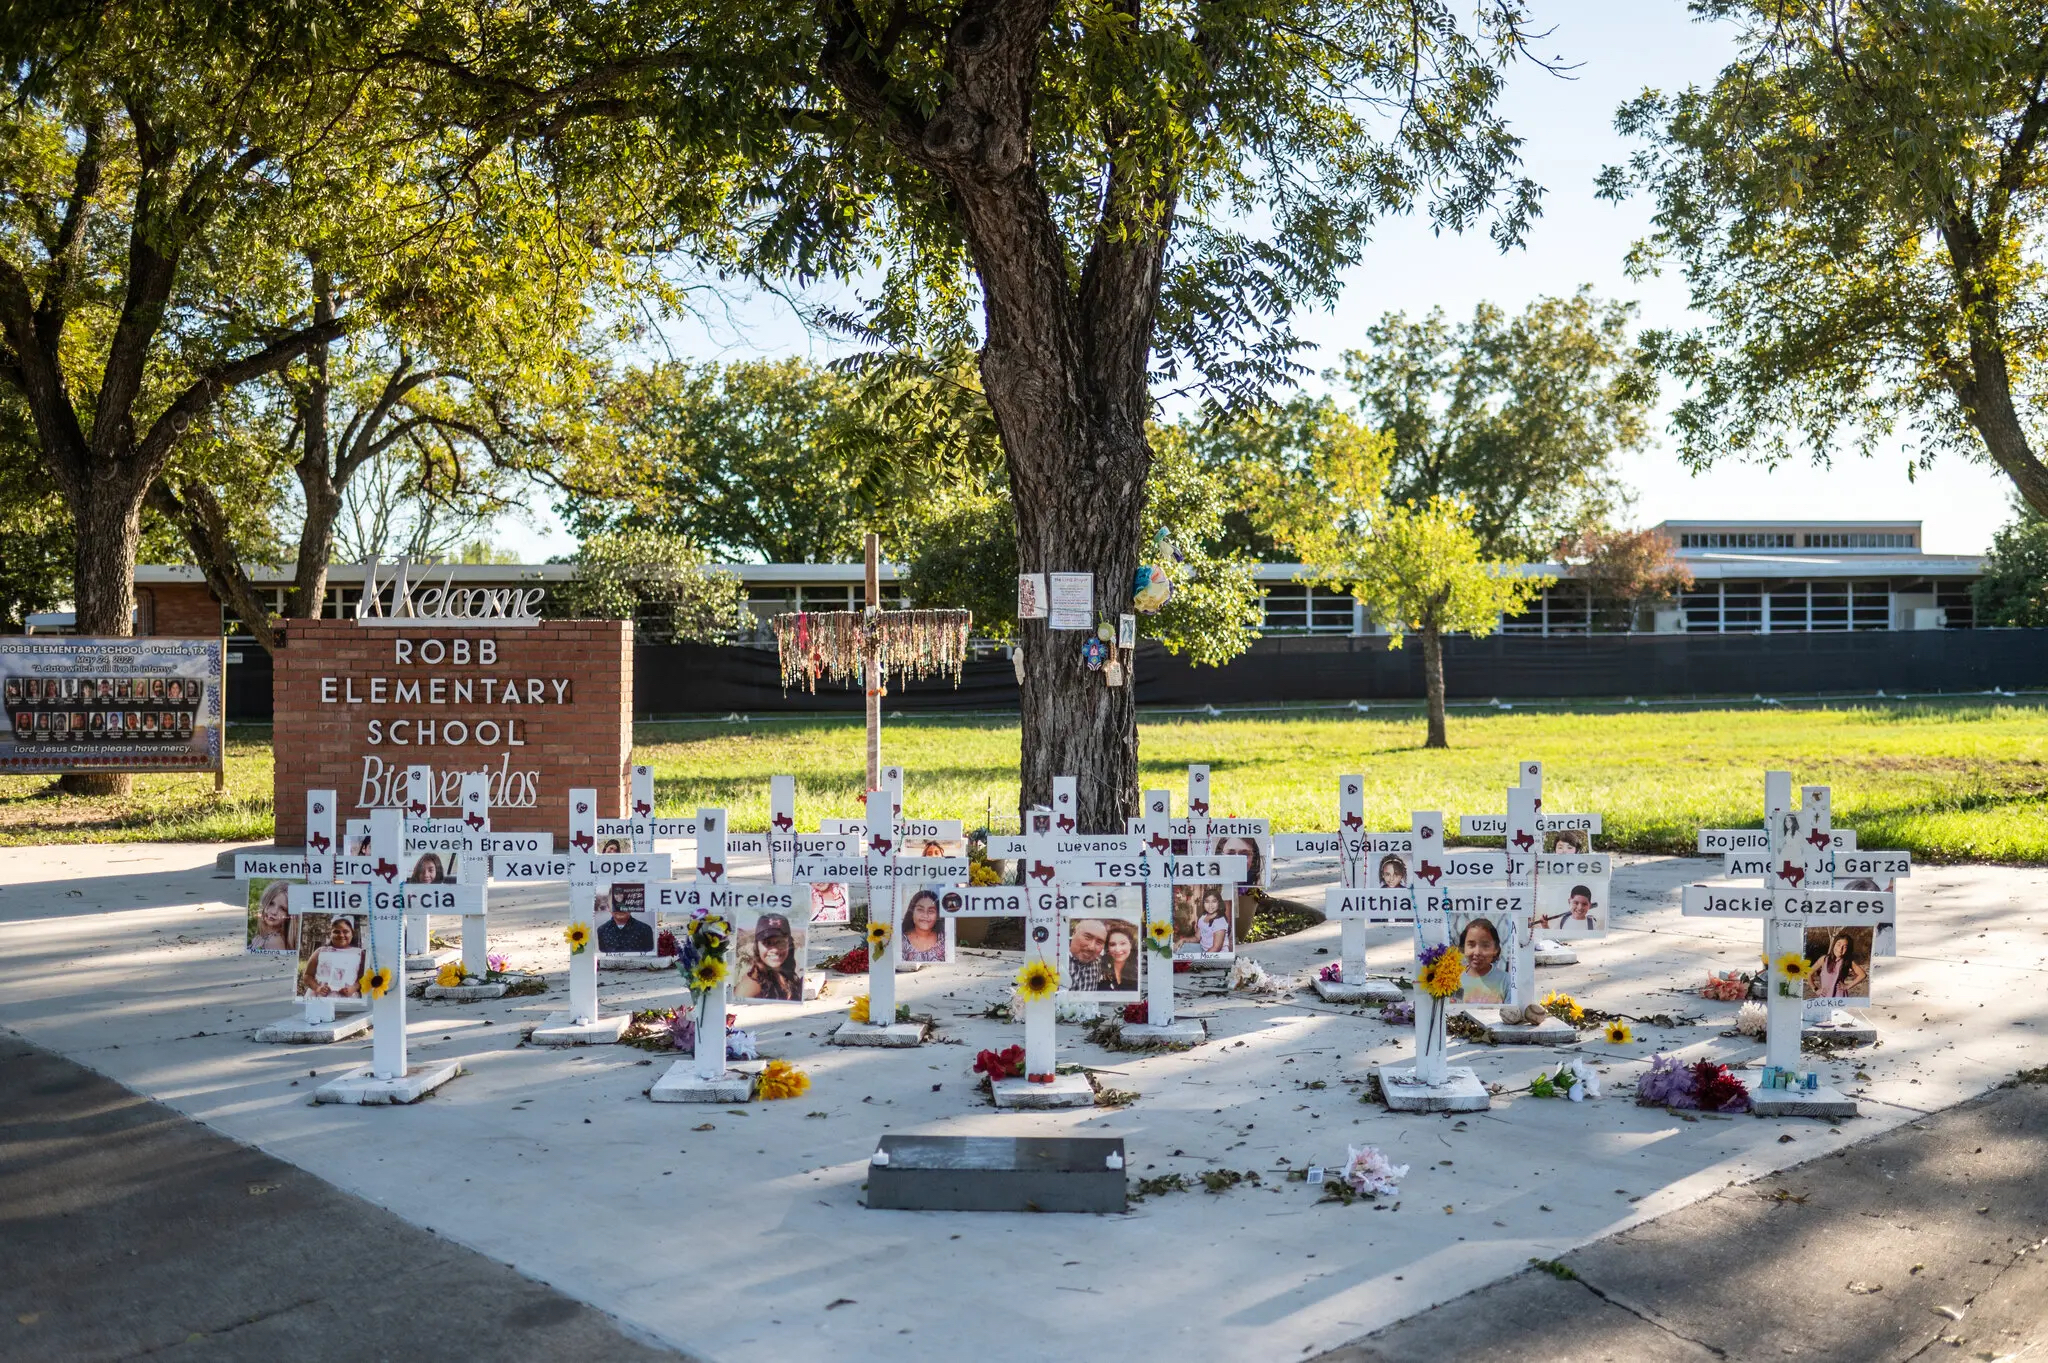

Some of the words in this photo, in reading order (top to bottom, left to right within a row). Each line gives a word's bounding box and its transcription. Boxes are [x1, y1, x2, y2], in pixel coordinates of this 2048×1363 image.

[359, 555, 545, 618] Welcome
[1, 645, 30, 654] ROBB
[33, 645, 98, 654] ELEMENTARY
[101, 646, 142, 654] SCHOOL
[152, 646, 191, 656] Uvalde,
[193, 647, 206, 655] TX
[395, 639, 498, 665] ROBB
[76, 656, 96, 664] May
[112, 656, 134, 664] 2022
[44, 664, 65, 672] date
[67, 664, 94, 673] which
[96, 664, 111, 673] will
[130, 664, 139, 673] in
[321, 677, 570, 705] ELEMENTARY
[367, 719, 525, 746] SCHOOL
[14, 745, 38, 754] Lord,
[40, 745, 68, 753] Jesus
[70, 744, 99, 753] Christ
[100, 745, 133, 754] please
[135, 745, 158, 753] have
[160, 745, 192, 754] mercy.
[412, 823, 464, 834] Rodrigu
[597, 823, 644, 835] ahana
[649, 823, 696, 835] Torre
[1134, 823, 1196, 835] Mnda
[1206, 823, 1262, 835] Mathis
[1471, 819, 1507, 834] Uziy
[1535, 818, 1591, 831] Garcia
[405, 837, 473, 851] Nevaeh
[481, 836, 538, 853] Bravo
[727, 840, 762, 852] ailah
[1057, 841, 1128, 853] Luevanos
[1296, 839, 1339, 854] Layla
[1350, 839, 1412, 853] Salaza
[1706, 834, 1768, 851] Rojelio
[244, 860, 322, 875] Makenna
[335, 861, 372, 875] Elro
[506, 860, 576, 877] Xavier
[590, 860, 648, 876] Lopez
[883, 864, 967, 879] Rodriguez
[1094, 861, 1152, 878] Tess
[1163, 861, 1221, 878] Mata
[1445, 859, 1494, 876] Jose
[1505, 858, 1525, 875] Jr
[1536, 859, 1603, 875] Flores
[1815, 858, 1836, 874] Jo
[1845, 858, 1909, 874] Garza
[312, 890, 362, 909] Ellie
[375, 889, 456, 912] Garcia
[659, 888, 701, 906] Eva
[710, 891, 793, 909] Mireles
[964, 893, 1020, 912] Irma
[1038, 892, 1118, 911] Garcia
[1340, 895, 1411, 913] Alithia
[1427, 895, 1522, 912] Ramirez
[1703, 895, 1772, 912] Jackie
[1784, 897, 1885, 914] Cazares
[250, 948, 281, 956] Makenna
[1510, 920, 1518, 990] Alithia
[1806, 998, 1847, 1010] Jackie
